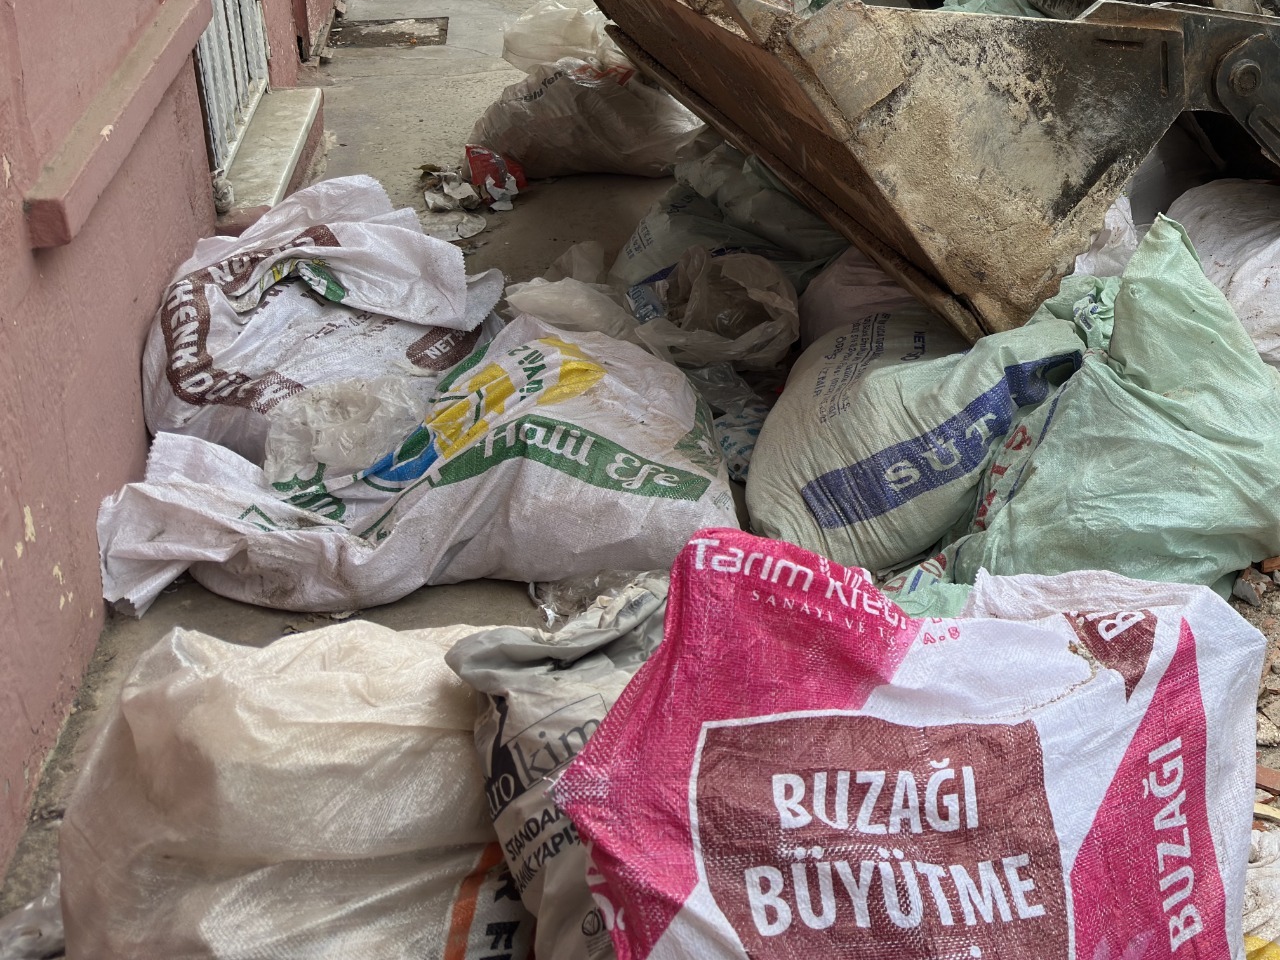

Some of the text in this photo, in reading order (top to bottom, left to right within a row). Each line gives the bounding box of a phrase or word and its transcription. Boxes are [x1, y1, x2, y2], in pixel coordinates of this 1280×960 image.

[423, 332, 456, 360] NET
[484, 421, 681, 490] Halil Efe
[687, 538, 814, 594] Tarım
[771, 758, 981, 836] BUZAĞI
[1141, 736, 1204, 953] BUZAĞI
[743, 844, 1047, 938] BÜYÜTME
